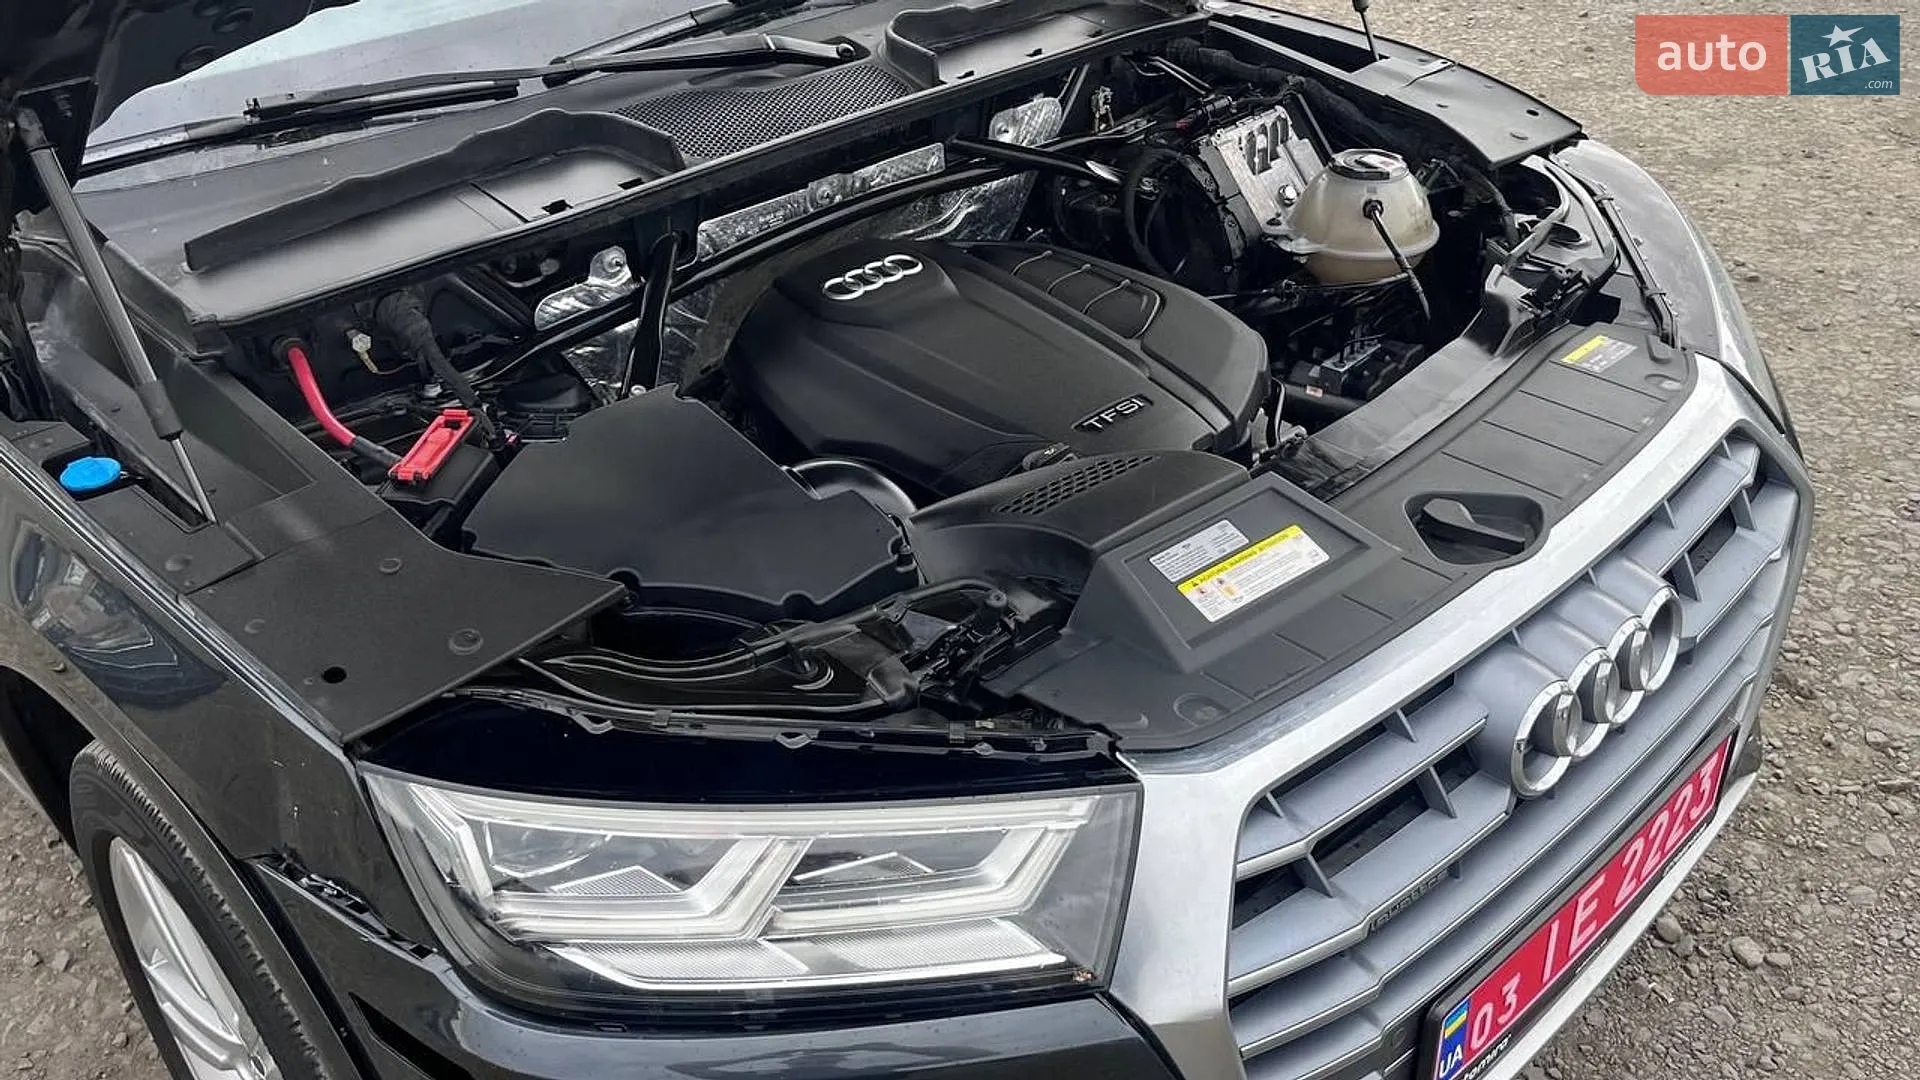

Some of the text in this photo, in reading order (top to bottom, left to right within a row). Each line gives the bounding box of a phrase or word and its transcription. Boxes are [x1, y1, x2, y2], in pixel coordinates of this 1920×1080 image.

[1082, 398, 1144, 428] TFSI
[1471, 971, 1521, 1050] 03
[1614, 752, 1719, 908] 2223
[1440, 1044, 1463, 1079] UA
